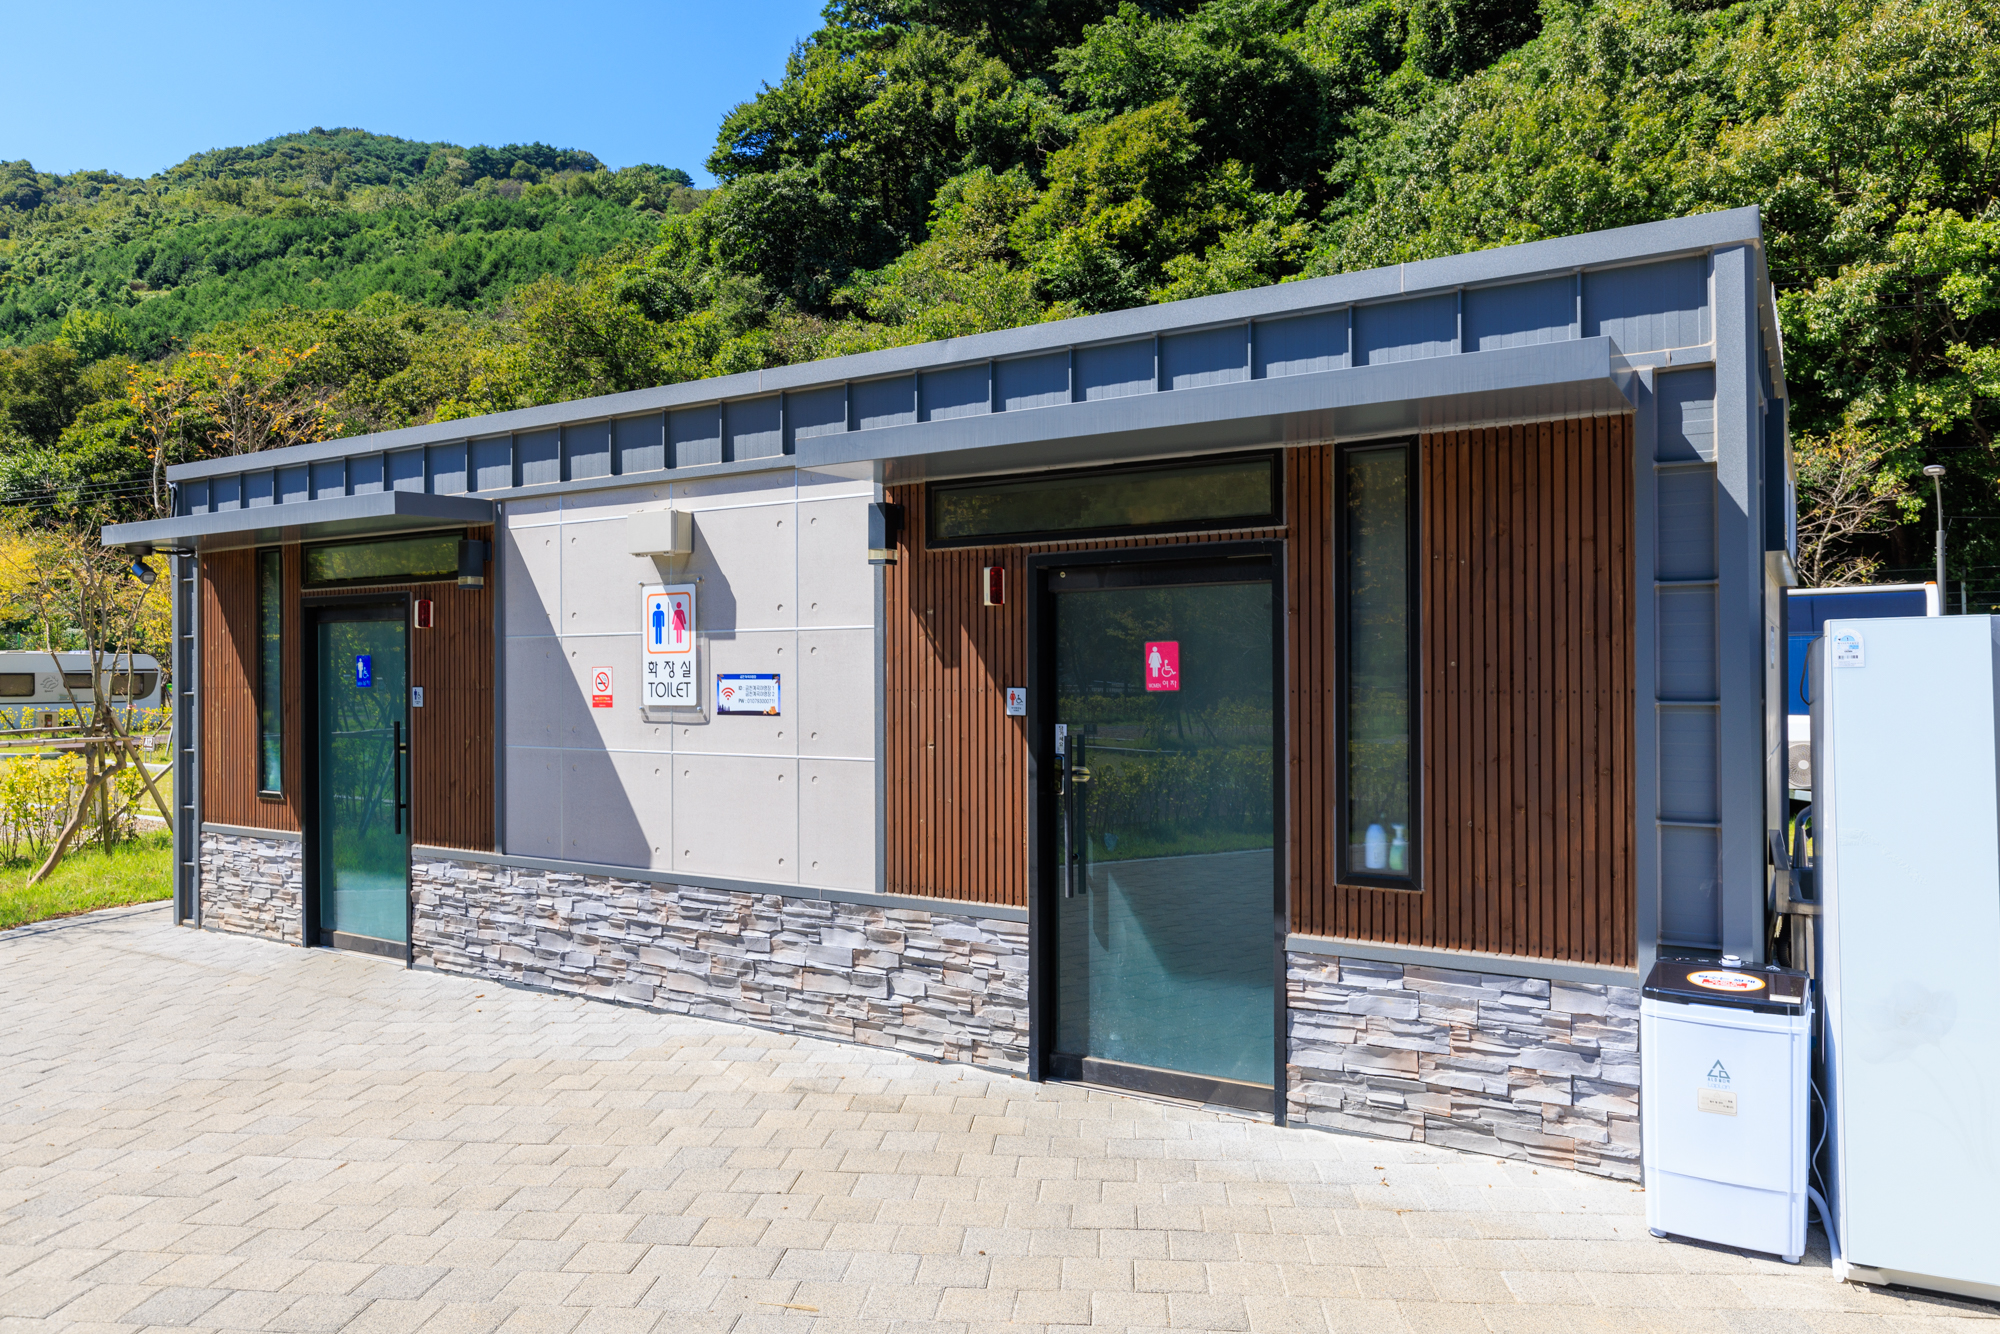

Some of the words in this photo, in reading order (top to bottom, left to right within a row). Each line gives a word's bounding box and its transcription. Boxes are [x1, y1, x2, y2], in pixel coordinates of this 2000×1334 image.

[648, 660, 690, 678] 화장실
[648, 682, 691, 698] TOILET
[1162, 680, 1177, 688] 여자
